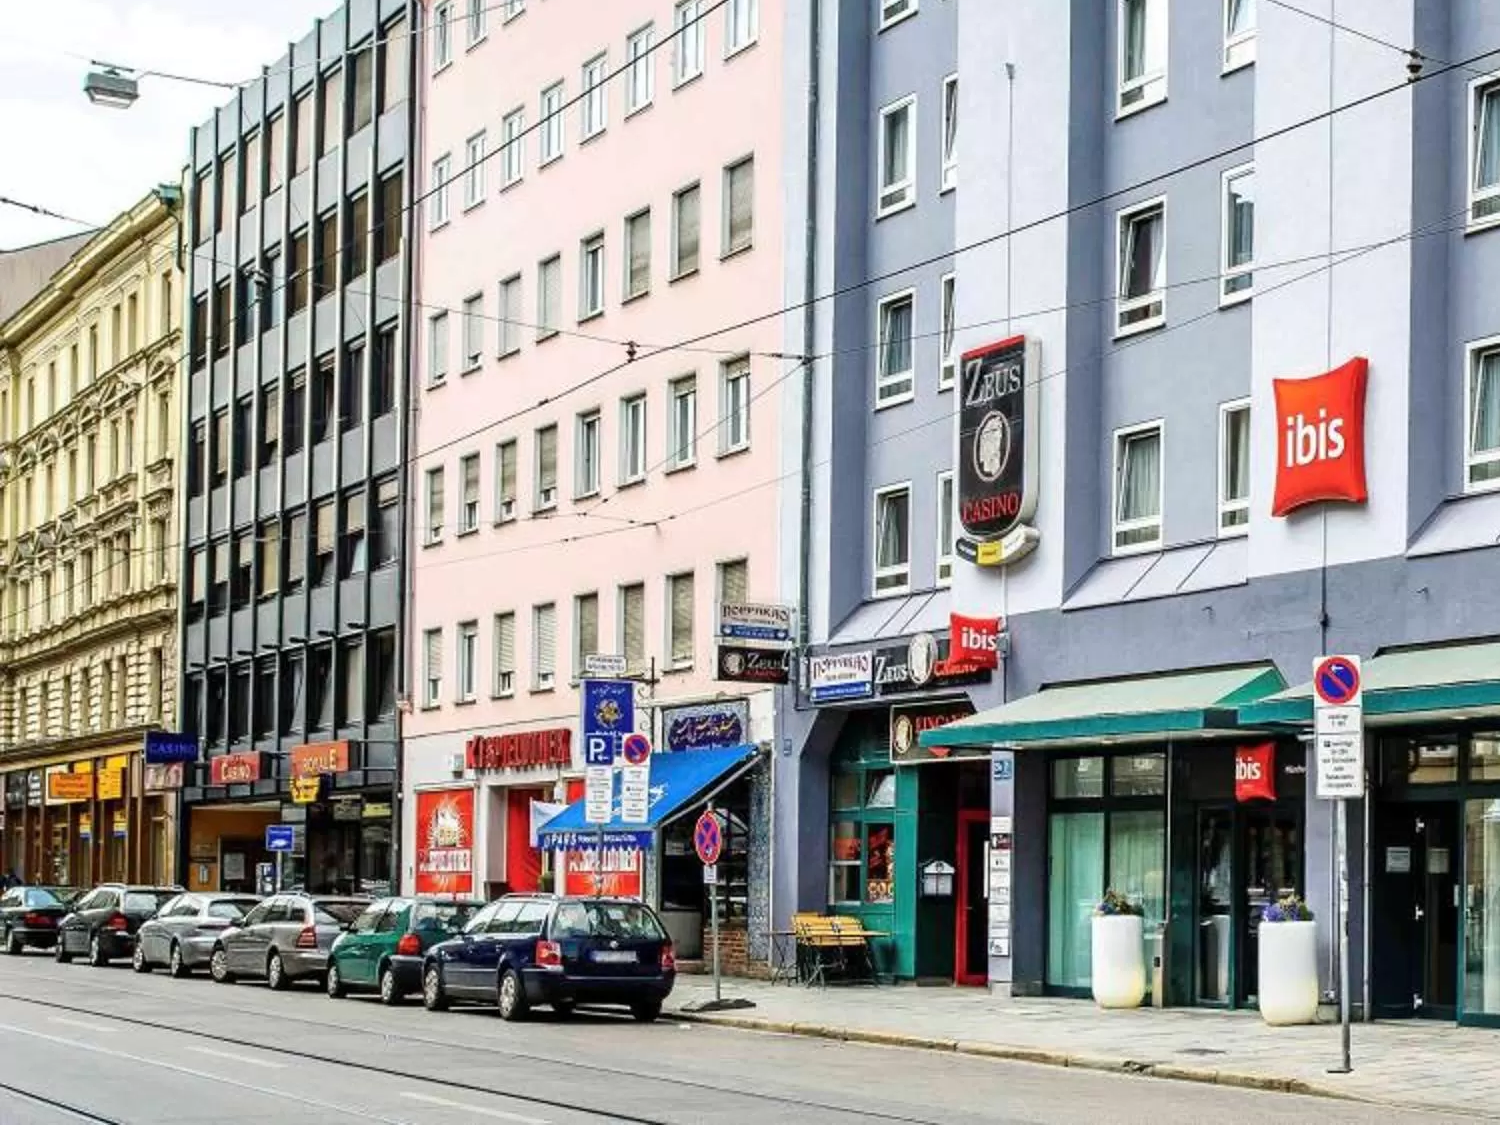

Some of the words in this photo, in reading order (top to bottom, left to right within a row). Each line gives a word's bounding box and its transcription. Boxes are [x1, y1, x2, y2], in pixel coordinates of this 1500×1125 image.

[1286, 407, 1345, 468] ibis
[963, 493, 1020, 525] CASINO
[961, 626, 997, 651] ibis
[1235, 756, 1261, 780] ibis
